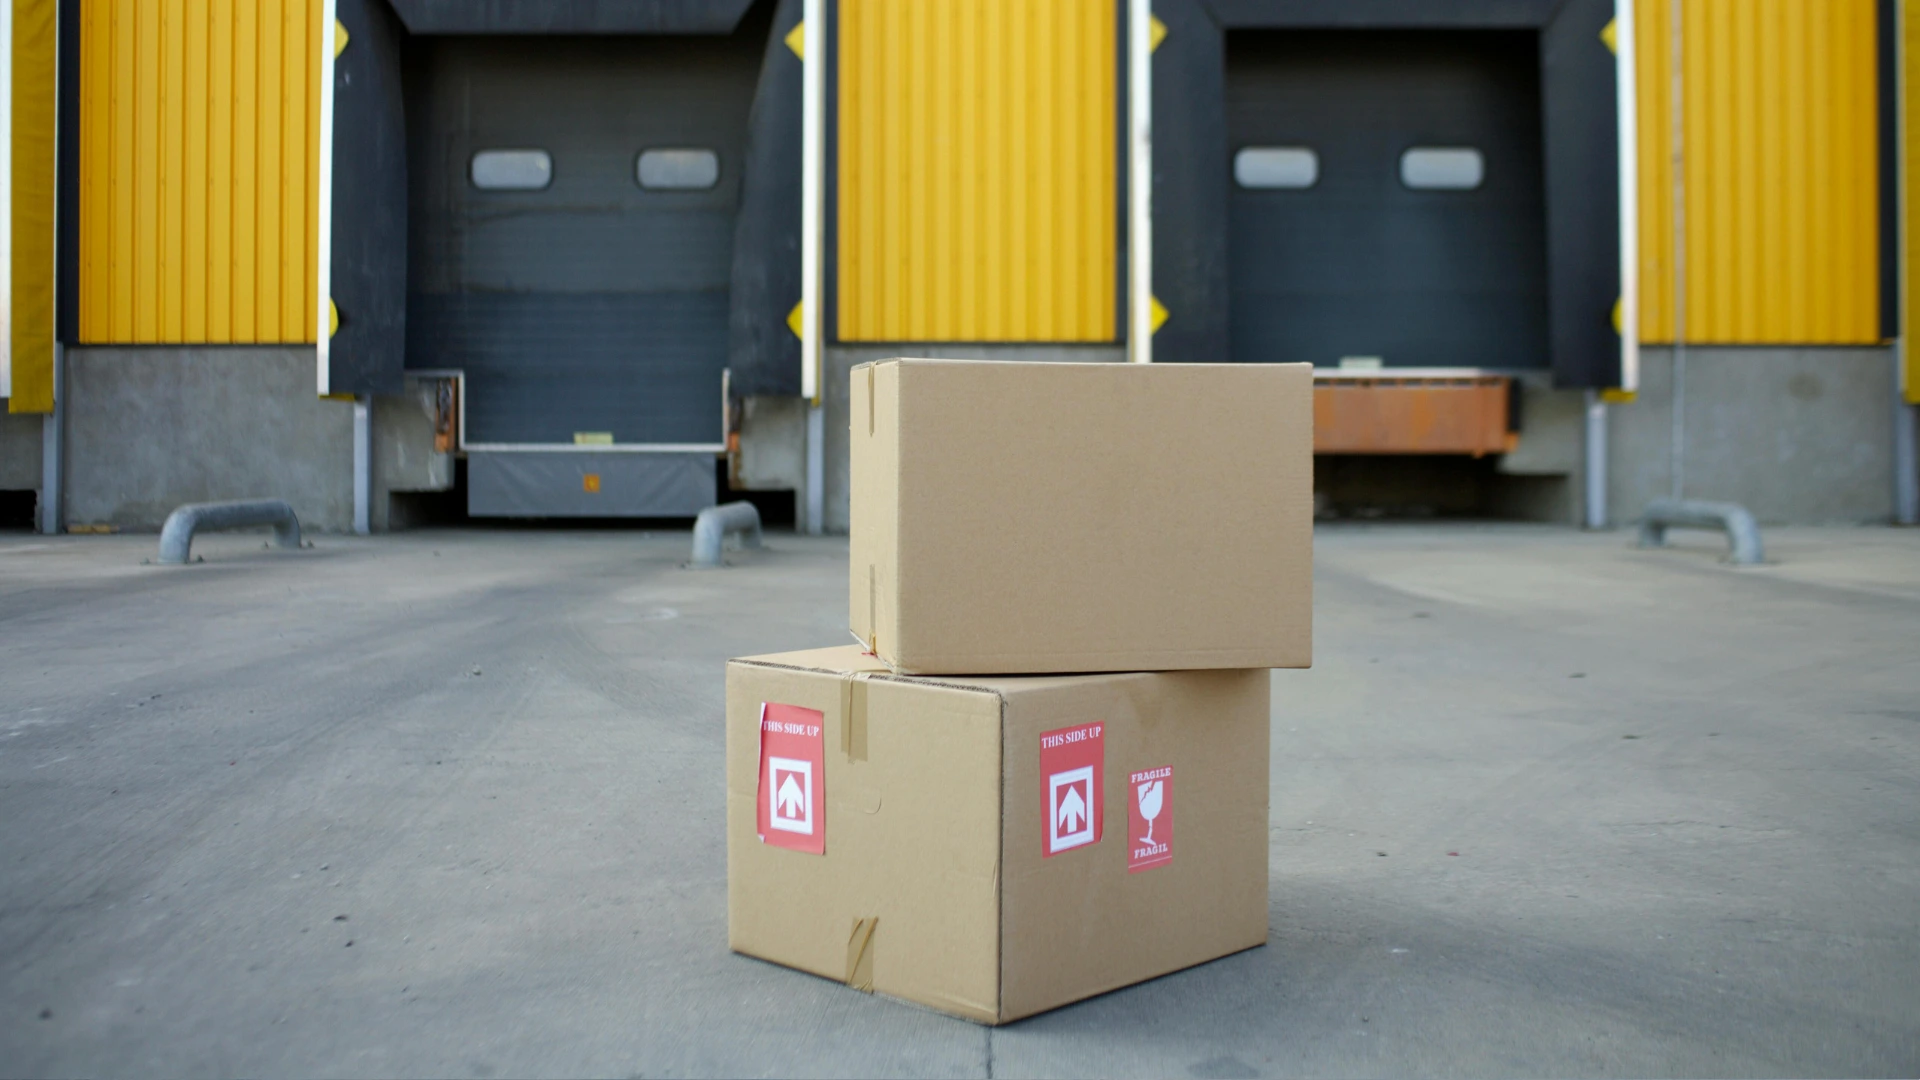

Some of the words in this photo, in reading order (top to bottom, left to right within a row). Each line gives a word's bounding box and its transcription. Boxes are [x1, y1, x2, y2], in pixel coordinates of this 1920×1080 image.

[763, 721, 782, 732] THIS
[784, 723, 804, 736] SIDE
[807, 725, 819, 737] UP
[1041, 734, 1064, 748] THIS
[1066, 729, 1087, 744] SIDE
[1089, 726, 1101, 738] UP
[1131, 767, 1171, 783] FRAGILE
[1134, 843, 1168, 859] FRAGIL
